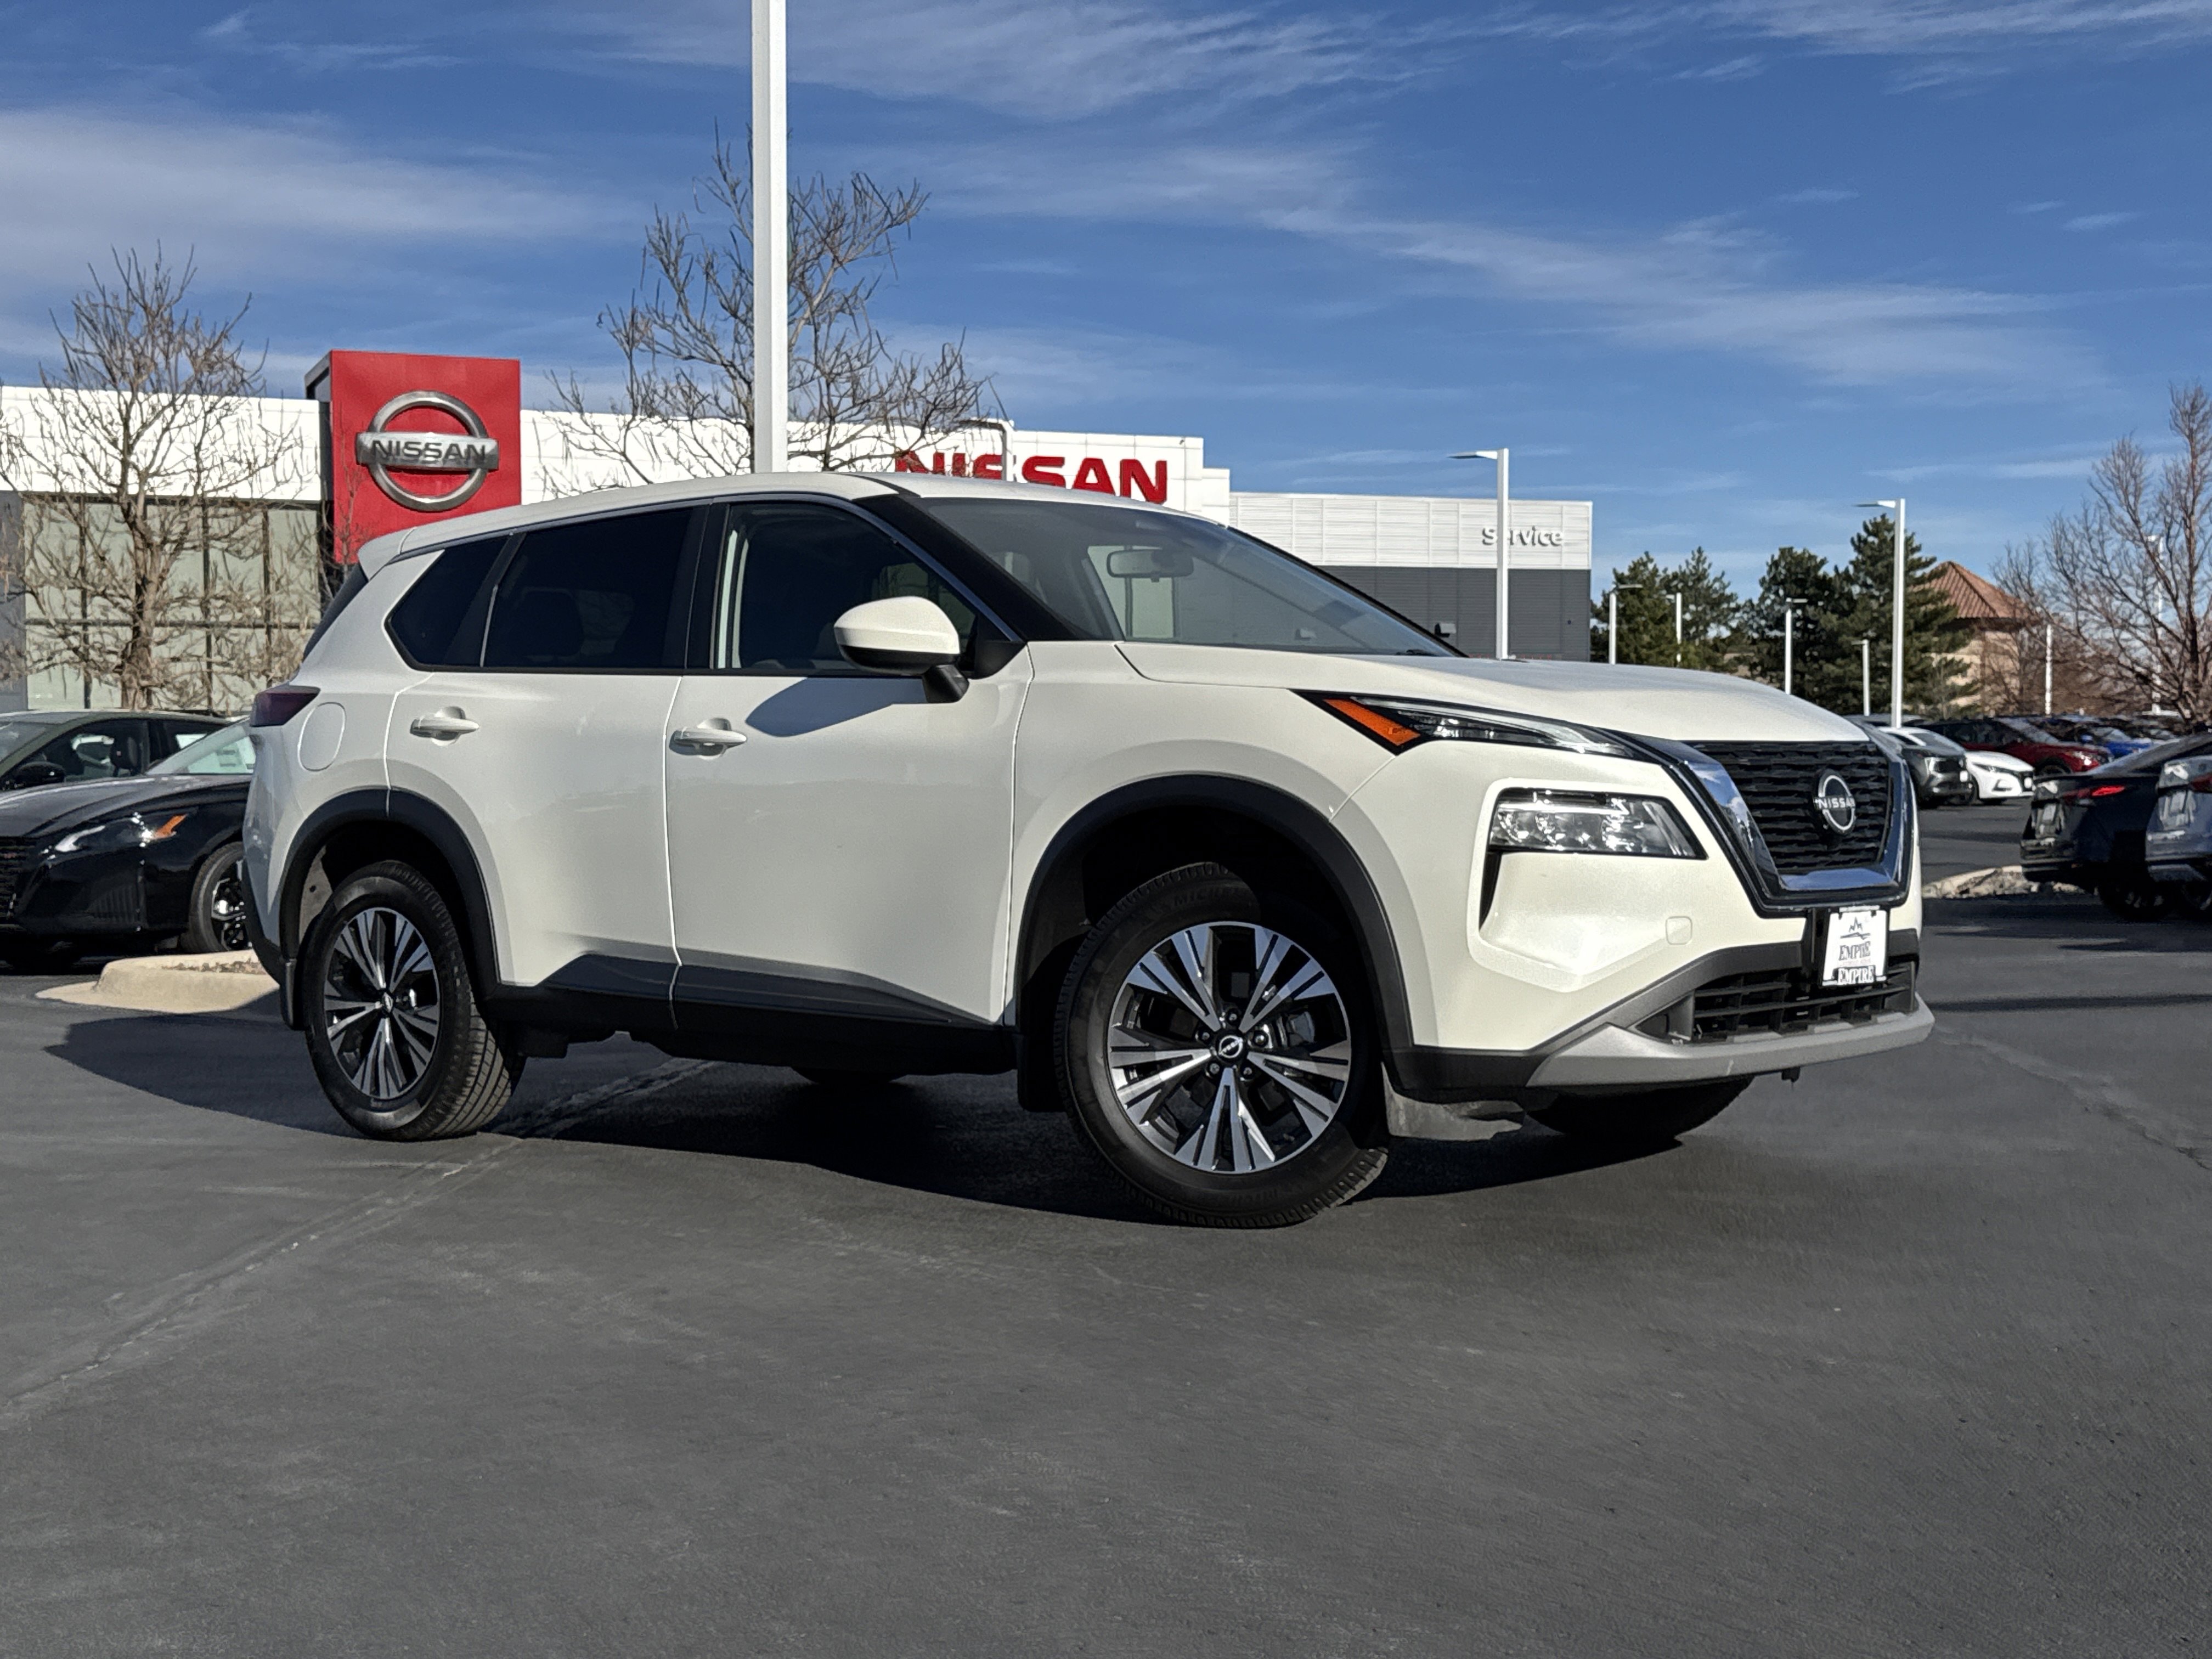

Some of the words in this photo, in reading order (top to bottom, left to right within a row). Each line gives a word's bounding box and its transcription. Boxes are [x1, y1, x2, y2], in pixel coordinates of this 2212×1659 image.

[371, 439, 486, 462] NISSAN
[1481, 525, 1564, 546] Srvice
[1838, 966, 1875, 986] EMPIRE
